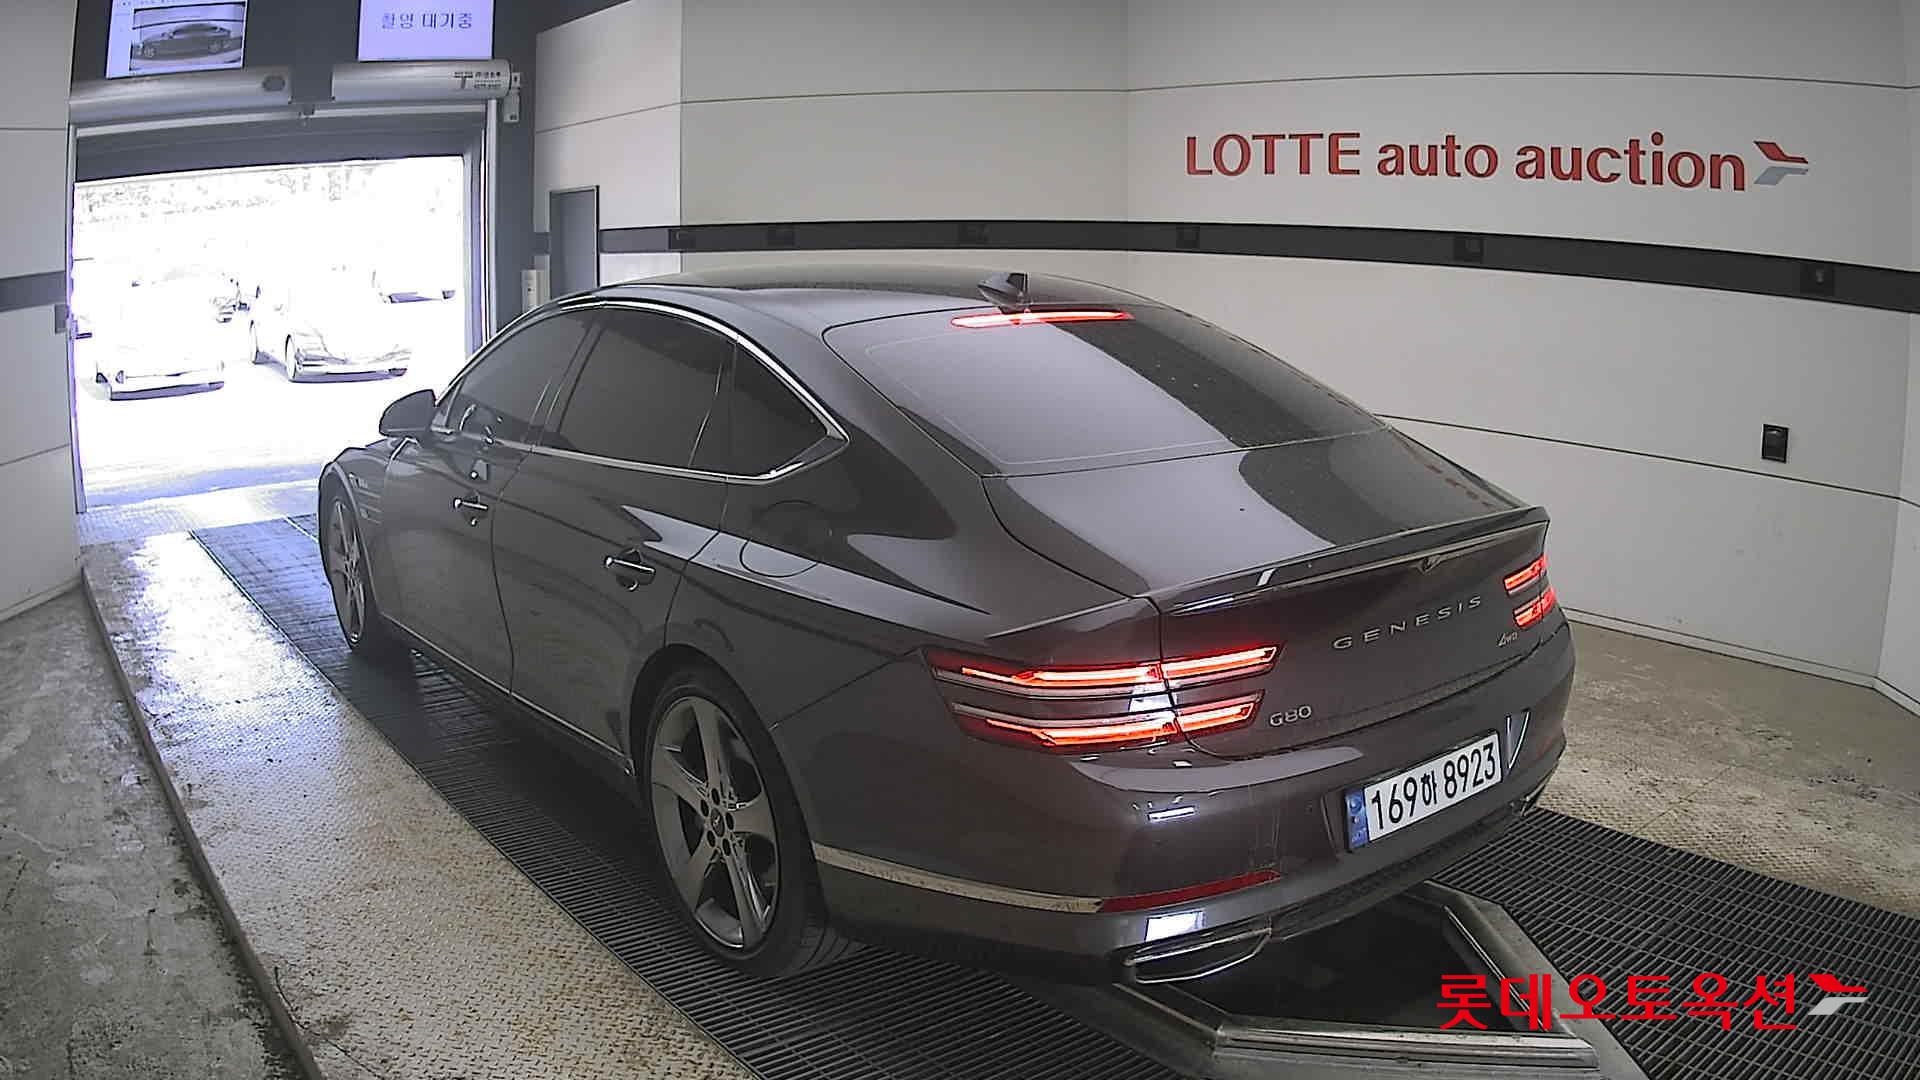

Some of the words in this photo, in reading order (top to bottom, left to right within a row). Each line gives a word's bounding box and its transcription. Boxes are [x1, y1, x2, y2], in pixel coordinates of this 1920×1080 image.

[422, 12, 472, 29] 대기중
[1186, 132, 1361, 176] LOTTE
[1377, 134, 1499, 178] auto
[1514, 131, 1746, 191] auction
[1333, 595, 1482, 649] GENESIS
[1269, 704, 1313, 727] G80
[1371, 771, 1438, 830] 169하
[1443, 742, 1497, 799] 8923
